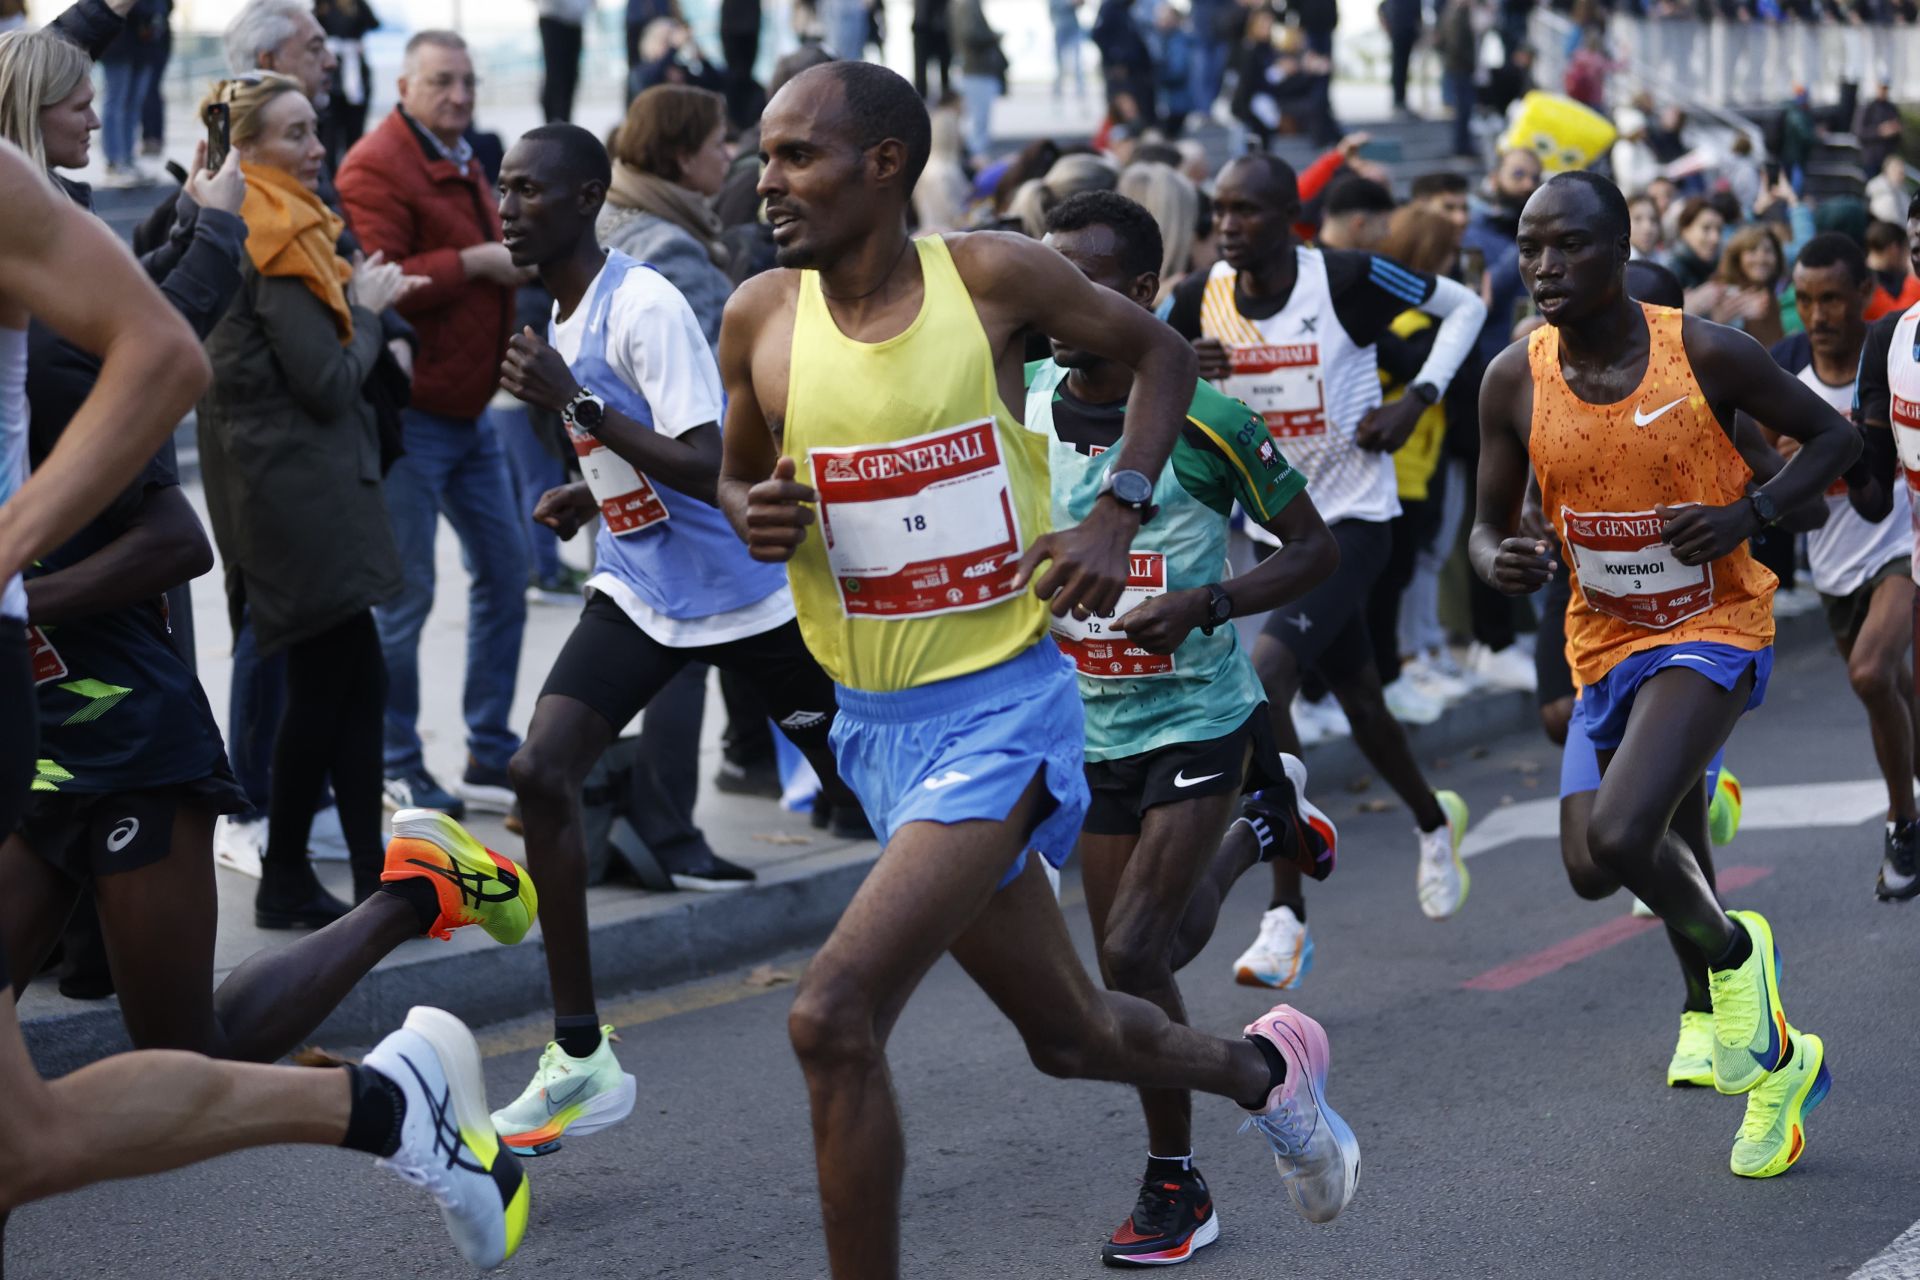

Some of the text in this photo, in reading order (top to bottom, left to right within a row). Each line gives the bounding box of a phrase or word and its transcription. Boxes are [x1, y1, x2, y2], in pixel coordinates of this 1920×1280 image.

[858, 432, 986, 480] GENERALI
[903, 515, 927, 532] 18
[1595, 518, 1664, 537] GENER
[962, 560, 998, 578] 42K
[1605, 562, 1664, 576] KWEMOI
[1633, 580, 1642, 589] 3
[1669, 594, 1692, 607] 42K
[1088, 623, 1102, 634] 12
